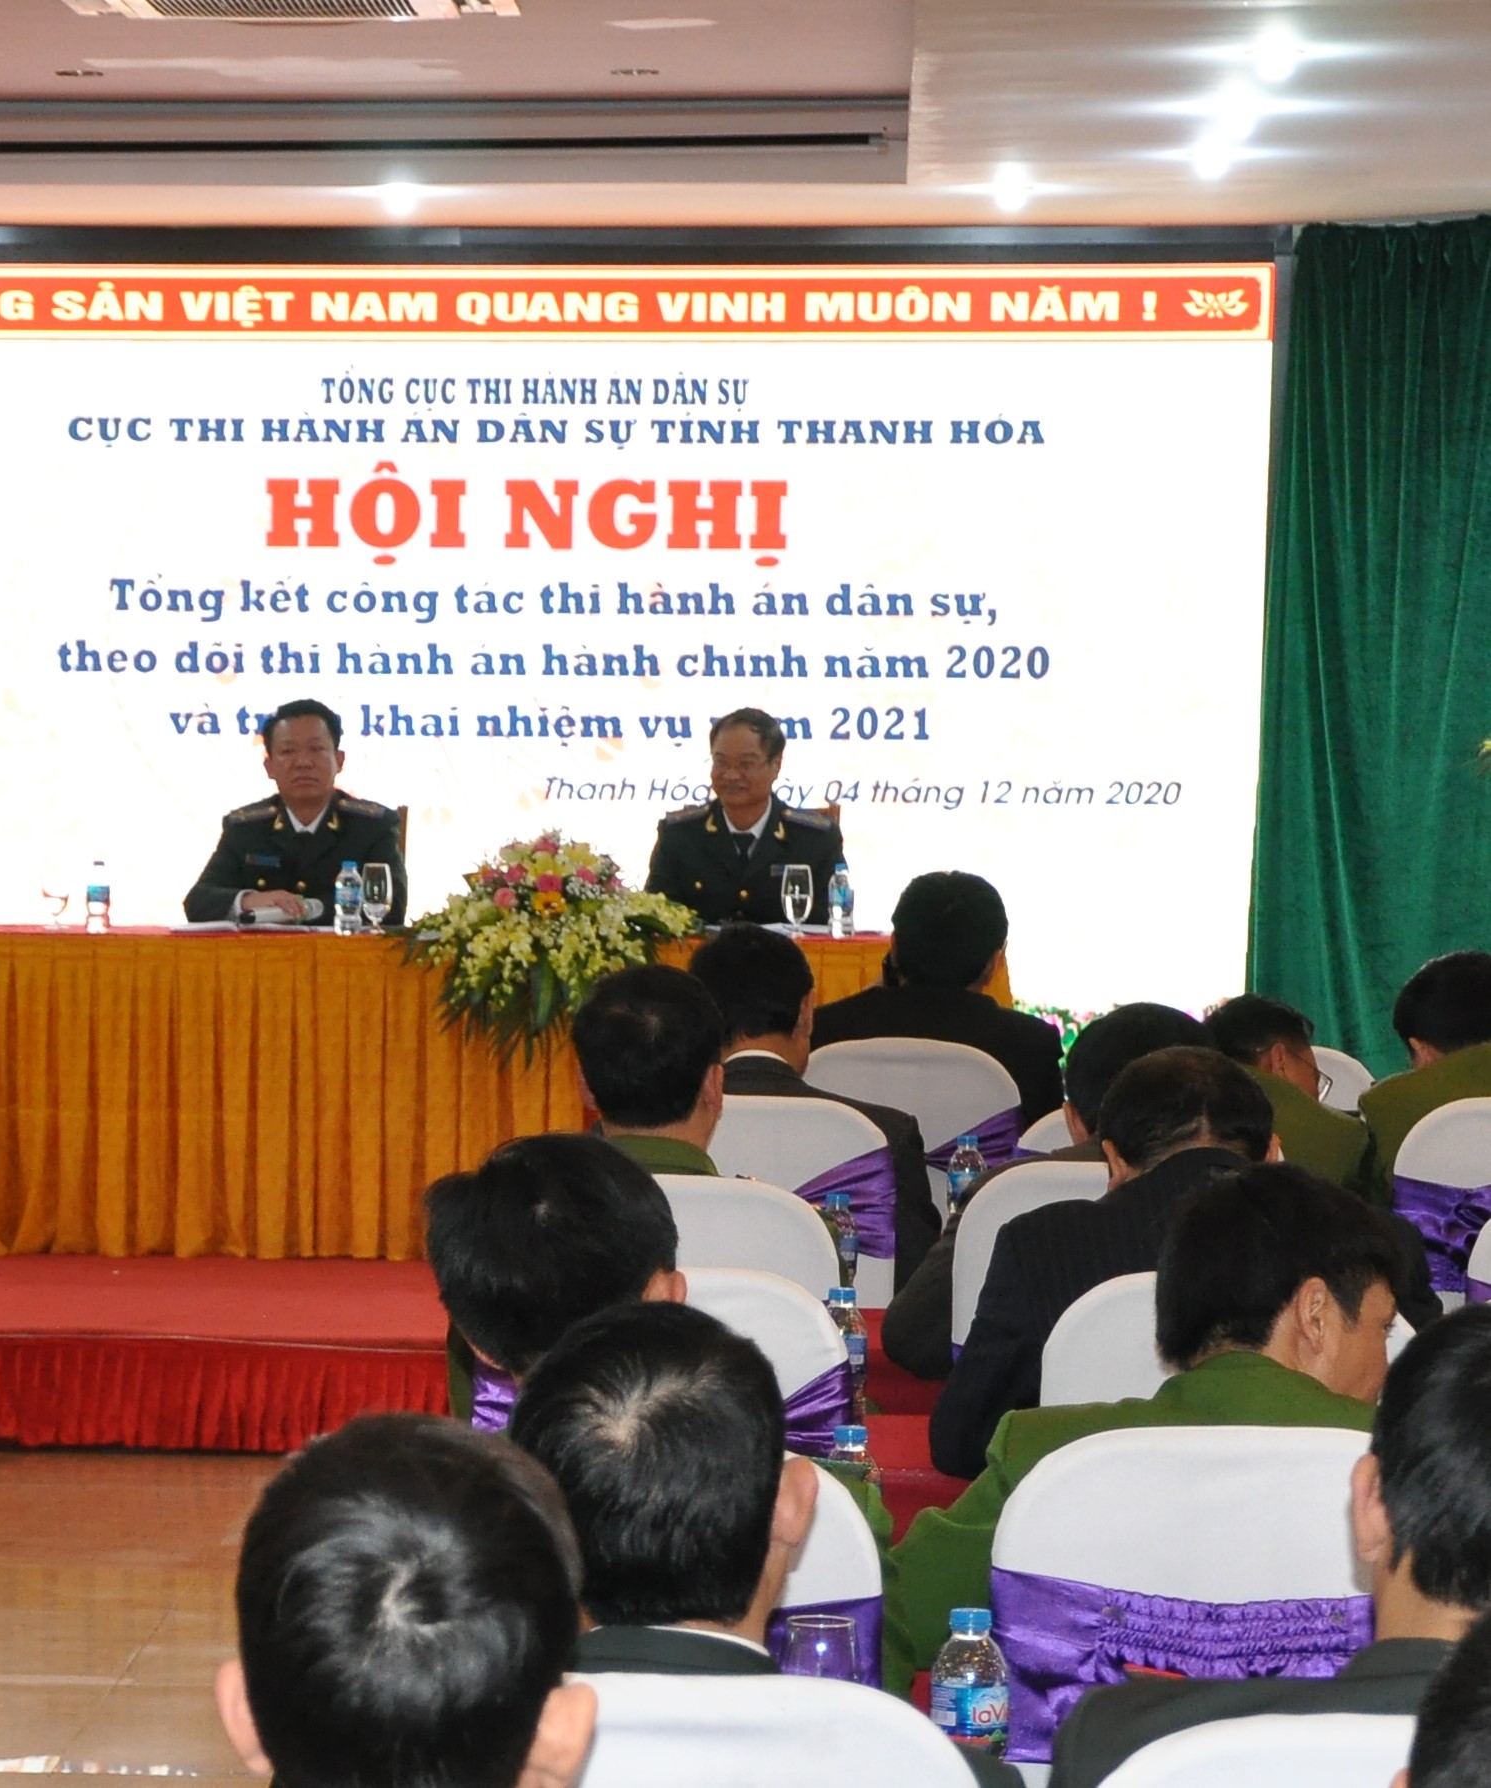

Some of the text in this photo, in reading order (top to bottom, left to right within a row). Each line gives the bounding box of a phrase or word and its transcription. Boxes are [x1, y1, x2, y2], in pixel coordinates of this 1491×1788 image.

[51, 283, 163, 322] SẢN
[180, 285, 295, 328] VIỆT
[311, 290, 438, 323] NAM
[456, 290, 640, 325] QUANG
[656, 290, 786, 323] VINH
[805, 285, 972, 323] MUÔN
[990, 285, 1121, 323] NĂM
[1141, 290, 1158, 322] !
[321, 366, 394, 405] TỔNG
[406, 377, 456, 412] CỤC
[467, 377, 512, 405] THI
[522, 370, 598, 405] HÀNH
[653, 372, 708, 405] DÂN
[718, 377, 750, 412] SỰ
[68, 411, 1045, 450] CỤC THI HÀNH ÁN DÂN SỰ TỈNH THANH HÓA
[266, 461, 789, 567] HỘI NGHỊ
[110, 574, 997, 627] Tổng kết công tác thi hành án dân sự,
[58, 640, 1050, 680] theo dõi thi hành án hành chính năm 2020
[169, 703, 221, 736] và
[360, 705, 460, 737] khai
[476, 705, 624, 747] nhiệm
[638, 715, 693, 748] vụ
[829, 706, 930, 741] 2021
[545, 776, 636, 801] Thanh
[824, 780, 861, 803] 04
[871, 778, 965, 811] tháng
[981, 780, 1012, 804] 12
[1021, 781, 1095, 805] năm
[1105, 781, 1182, 805] 2020
